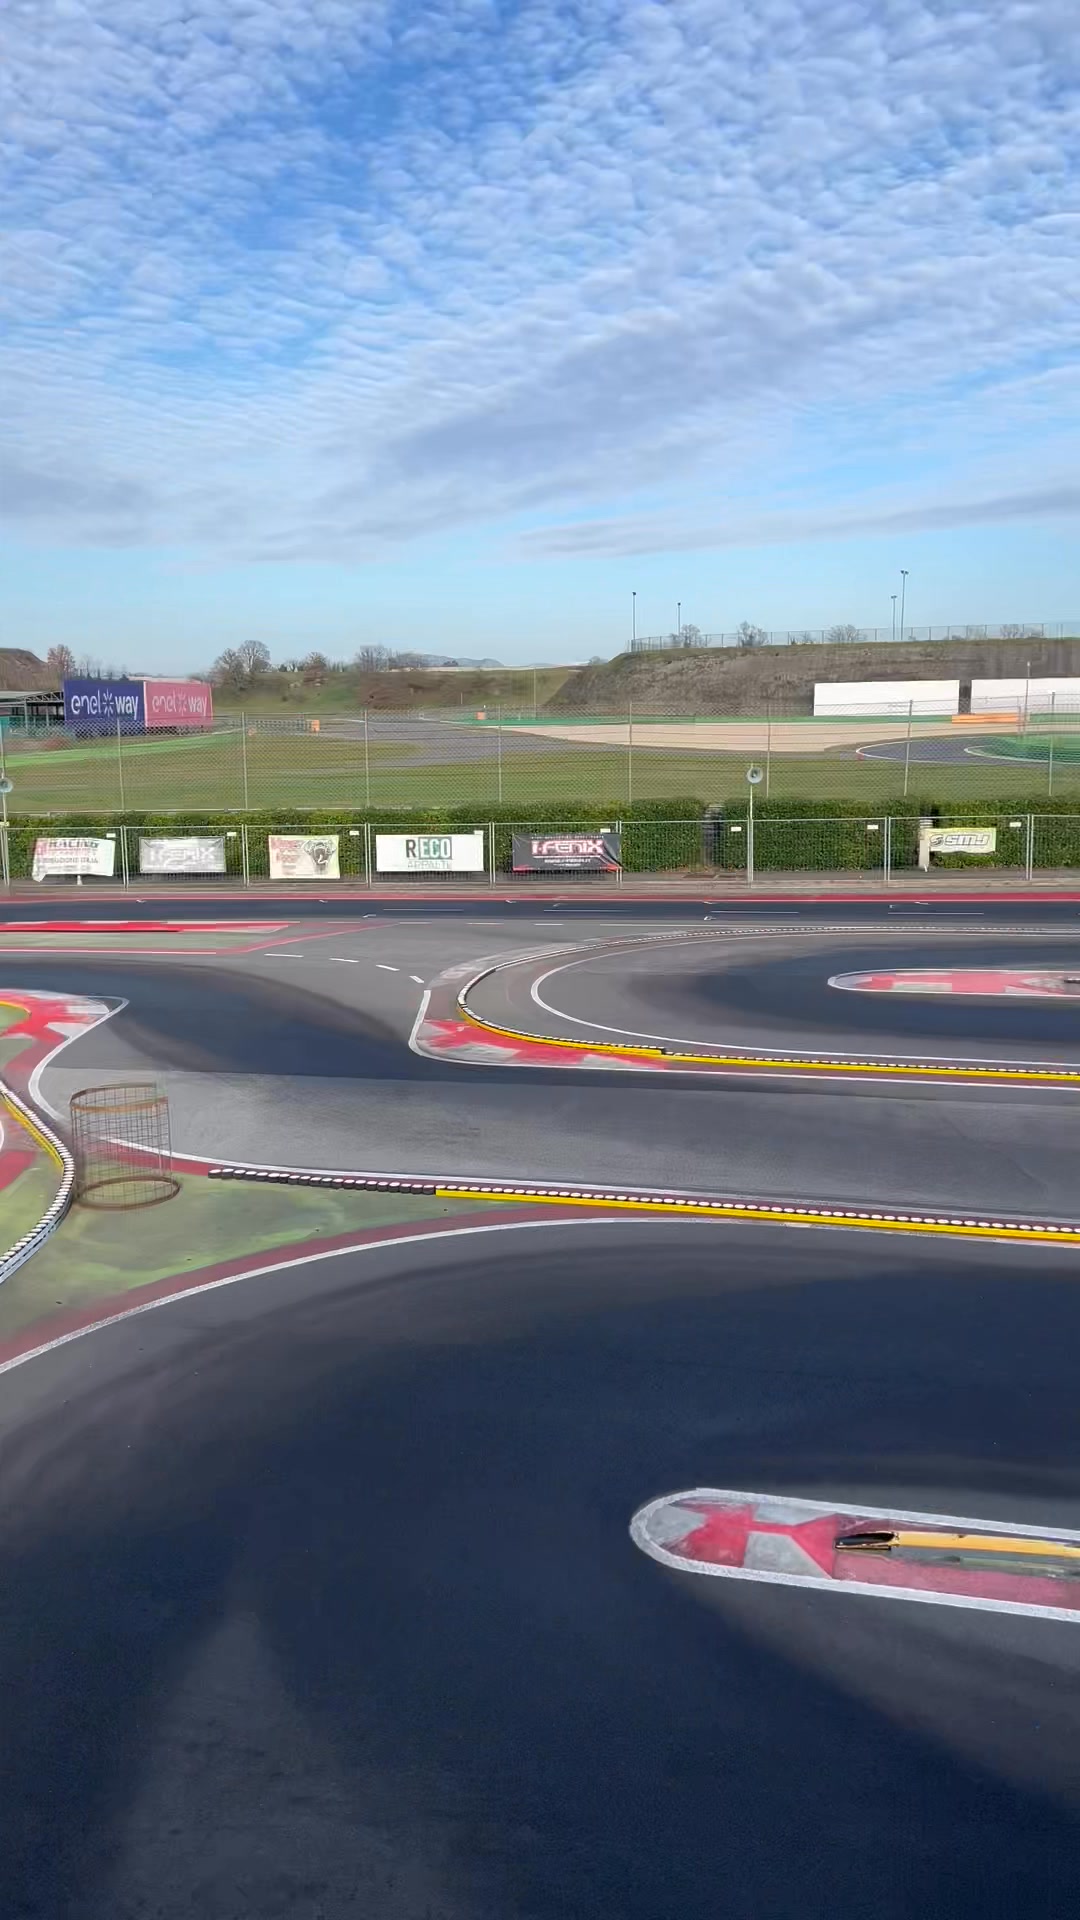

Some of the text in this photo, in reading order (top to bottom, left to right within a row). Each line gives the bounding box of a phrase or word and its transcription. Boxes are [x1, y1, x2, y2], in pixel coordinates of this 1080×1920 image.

[71, 690, 139, 720] enel way
[152, 690, 208, 717] enel way
[405, 838, 451, 858] RECO
